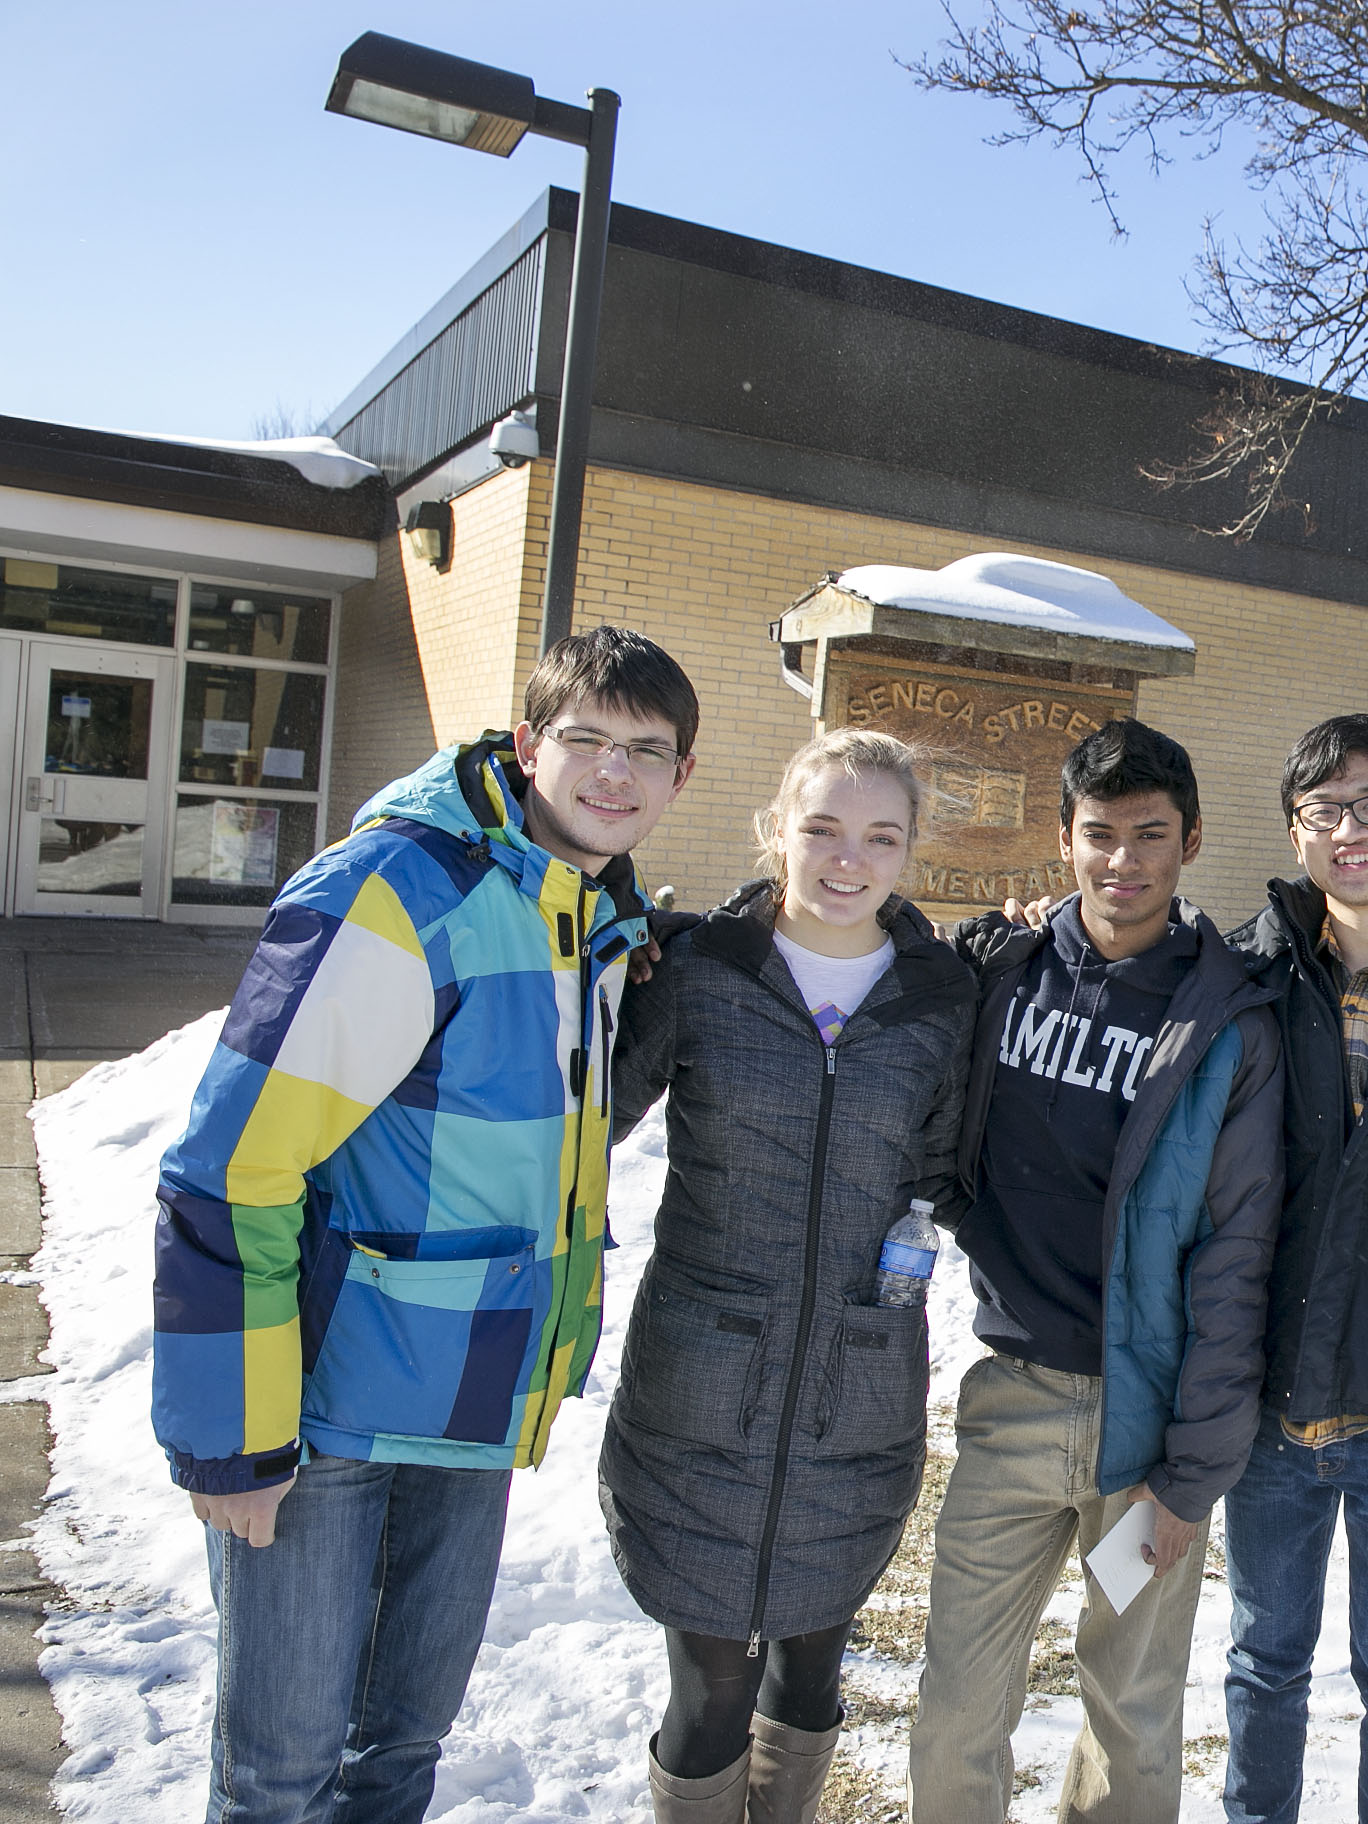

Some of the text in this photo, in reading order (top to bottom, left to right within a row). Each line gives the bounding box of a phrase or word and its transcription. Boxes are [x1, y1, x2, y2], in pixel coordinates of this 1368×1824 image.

[848, 680, 975, 730] SENECA
[903, 858, 1069, 899] MENTAR
[999, 996, 1154, 1101] MILTO
